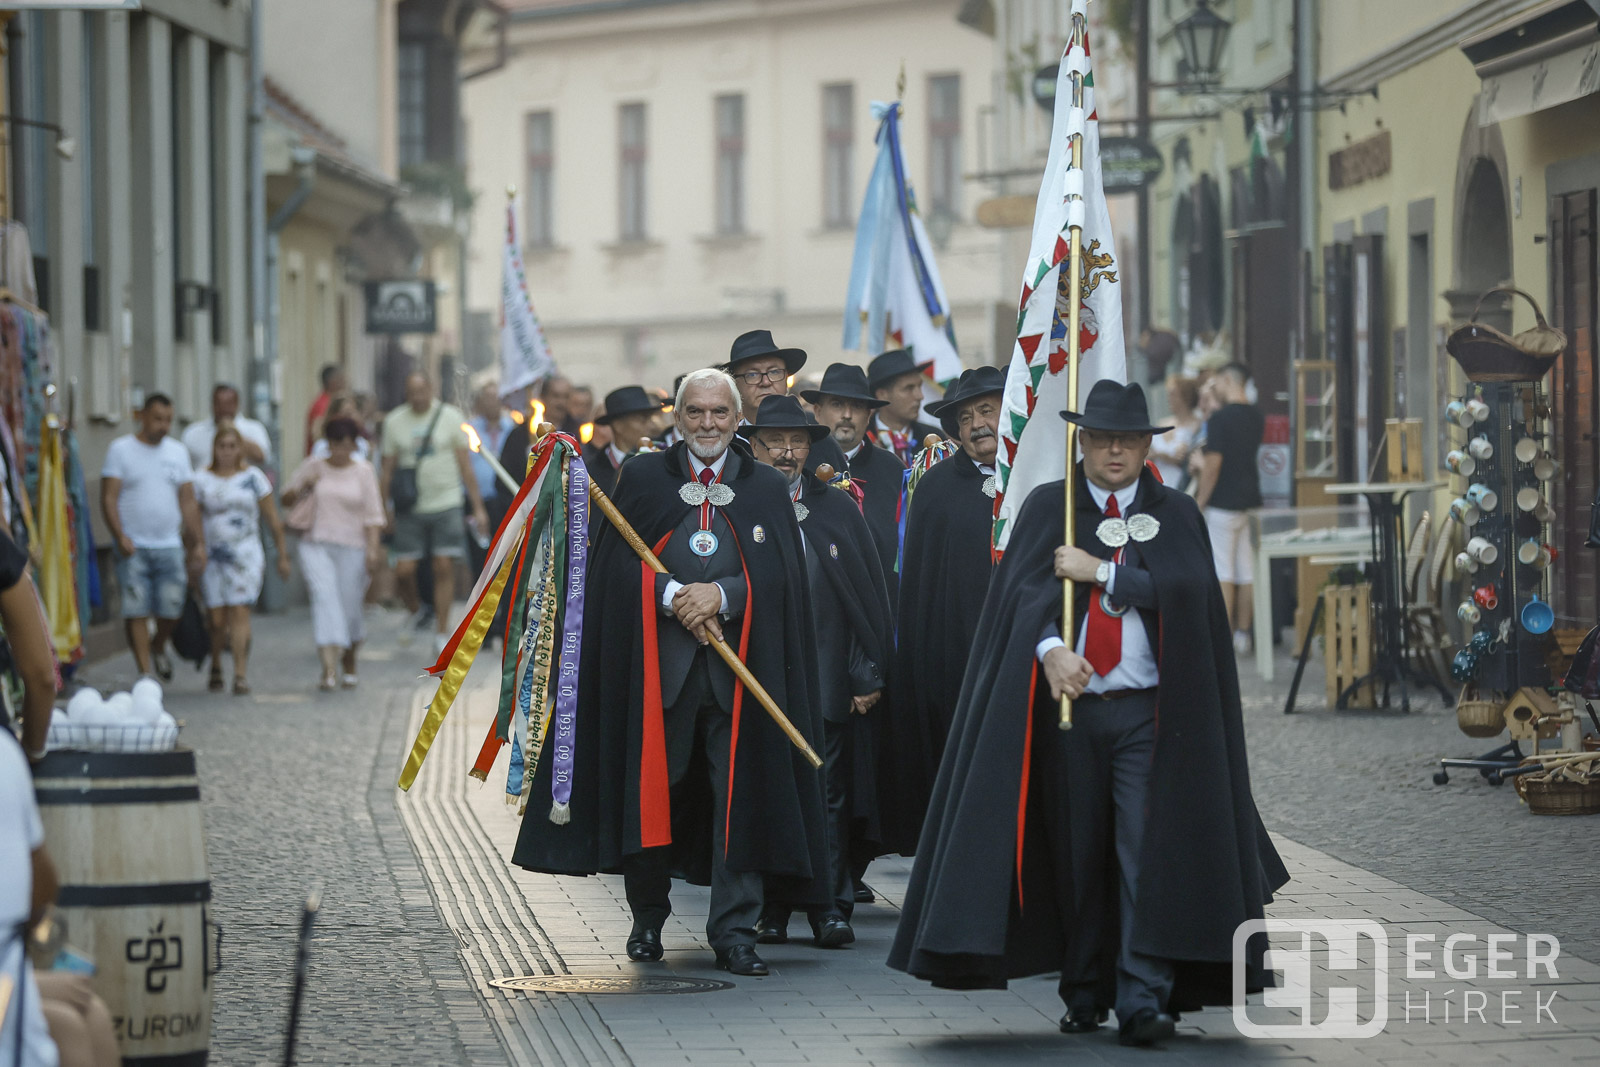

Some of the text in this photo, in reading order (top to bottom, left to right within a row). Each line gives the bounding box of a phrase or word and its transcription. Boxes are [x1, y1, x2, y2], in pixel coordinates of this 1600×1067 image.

[571, 501, 586, 561] Menyhért
[570, 566, 585, 600] elnök
[563, 631, 577, 656] 1931.
[562, 661, 575, 679] 05.
[561, 684, 573, 697] 10
[558, 712, 571, 740] 1935.
[557, 745, 570, 763] 09.
[556, 767, 569, 785] 30.
